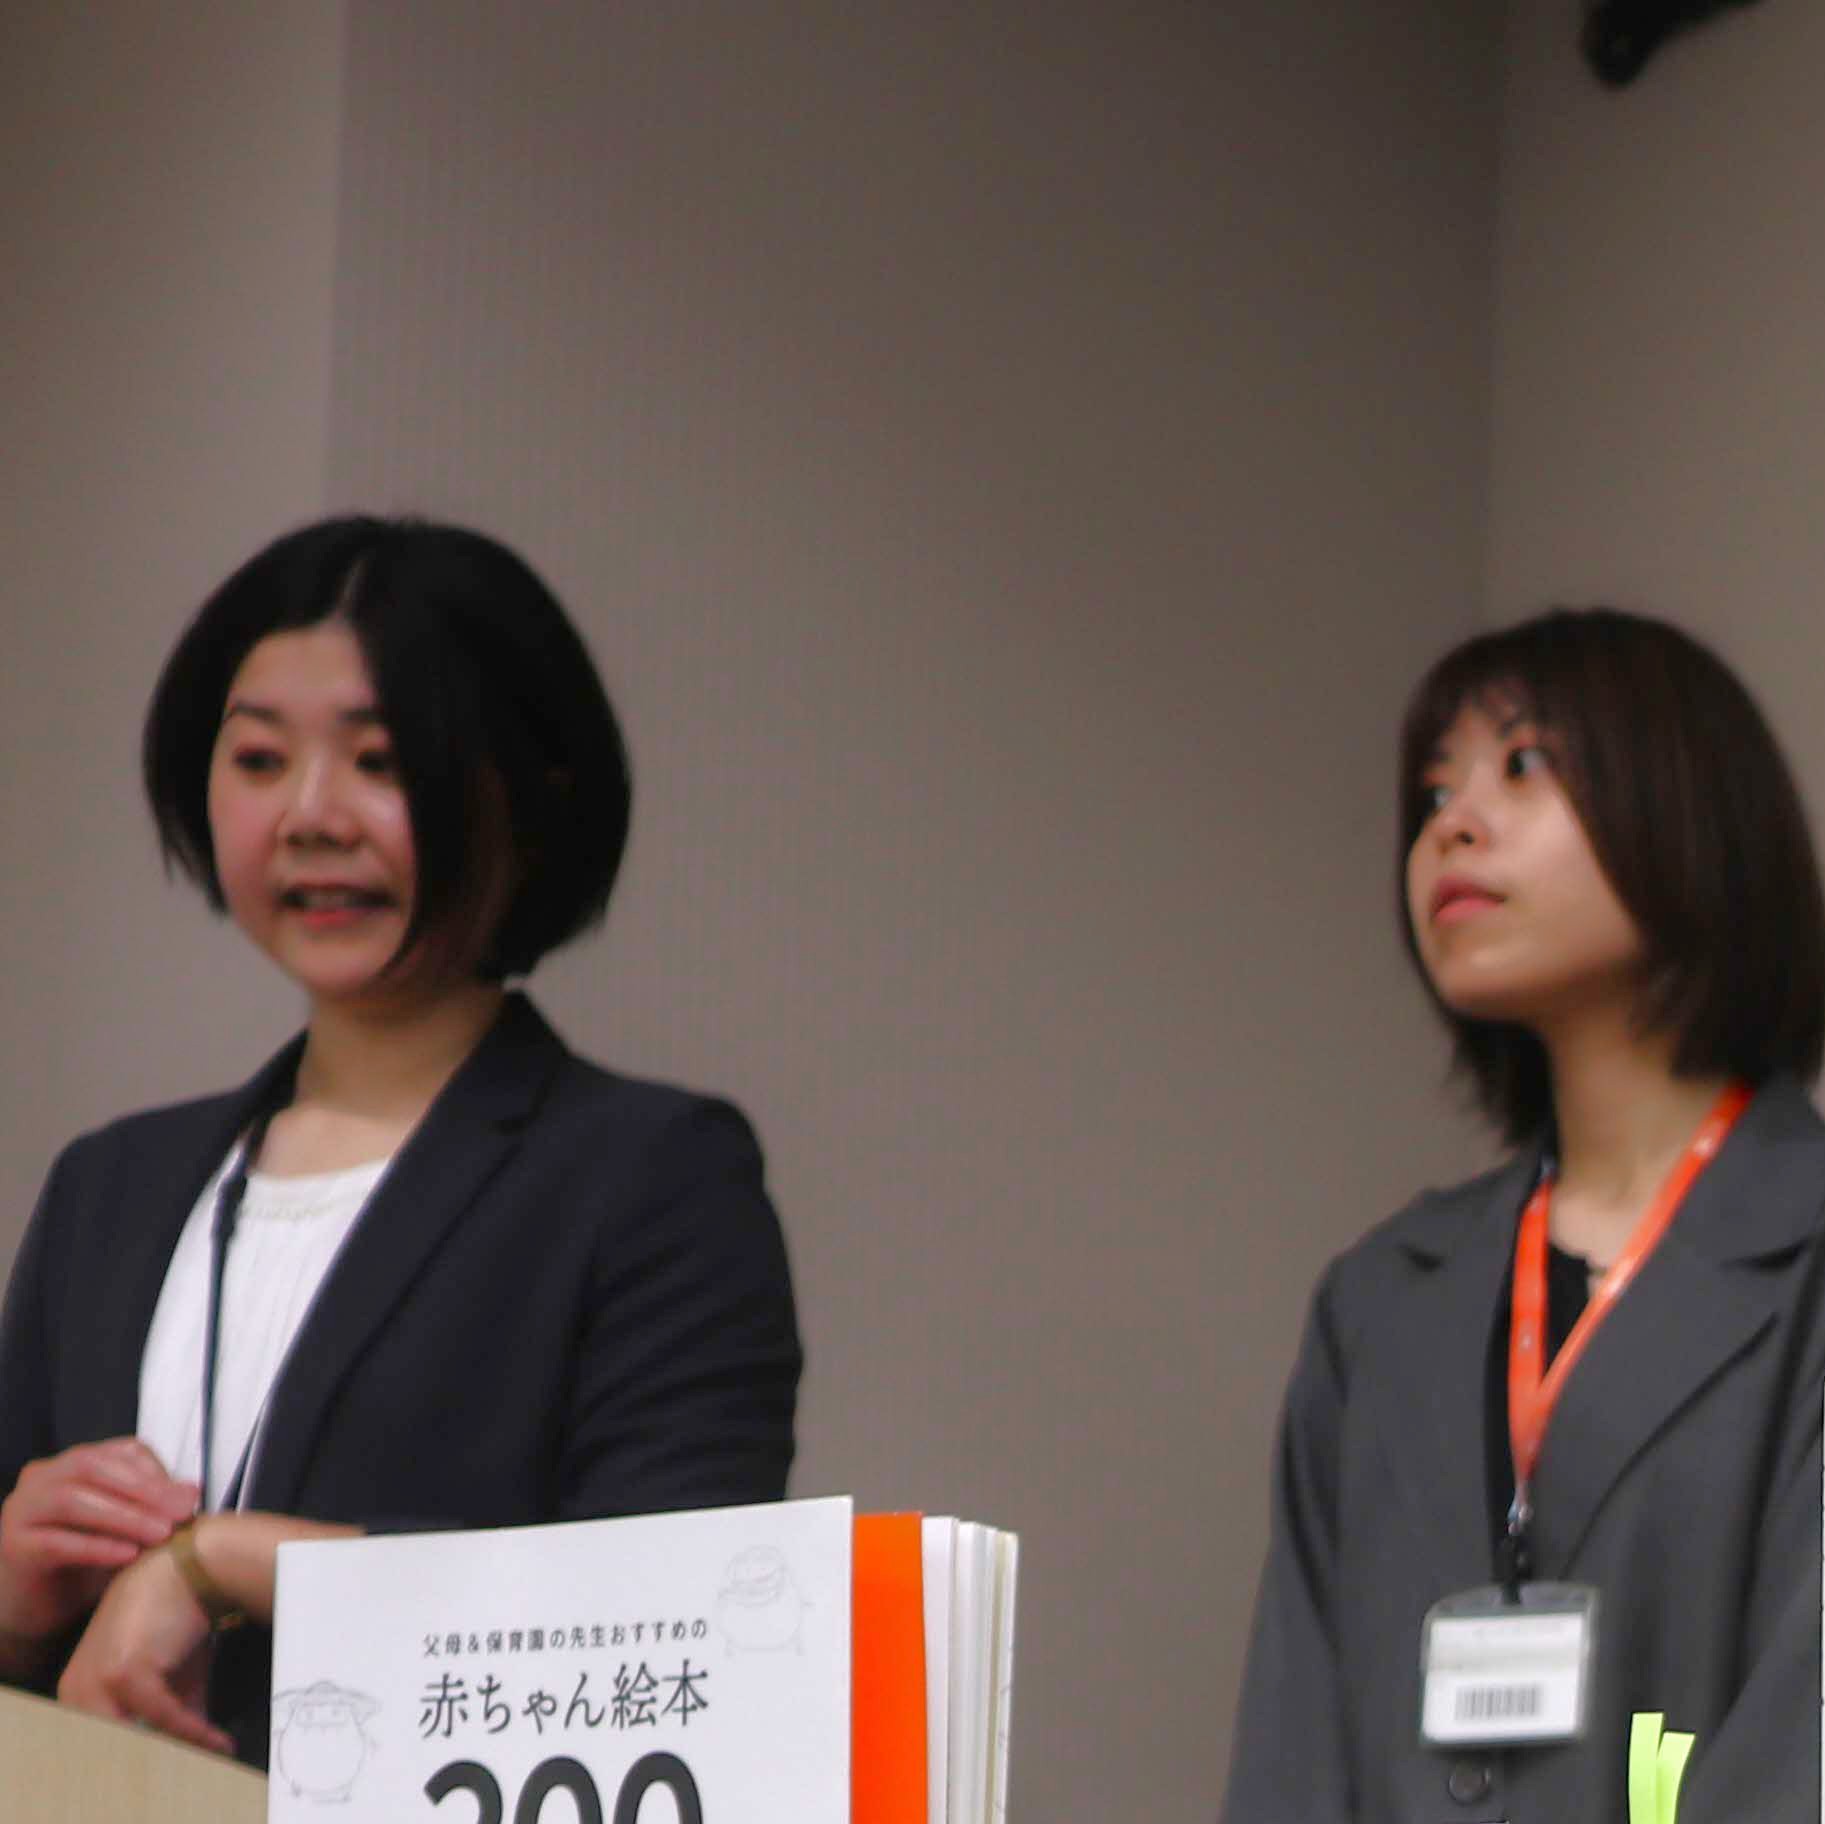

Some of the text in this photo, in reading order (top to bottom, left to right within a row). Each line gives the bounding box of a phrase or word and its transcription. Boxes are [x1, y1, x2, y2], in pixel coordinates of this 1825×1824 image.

[422, 1617, 709, 1657] 父母&保育園の先生おすすめの
[418, 1658, 709, 1739] 赤ちゃん絵本
